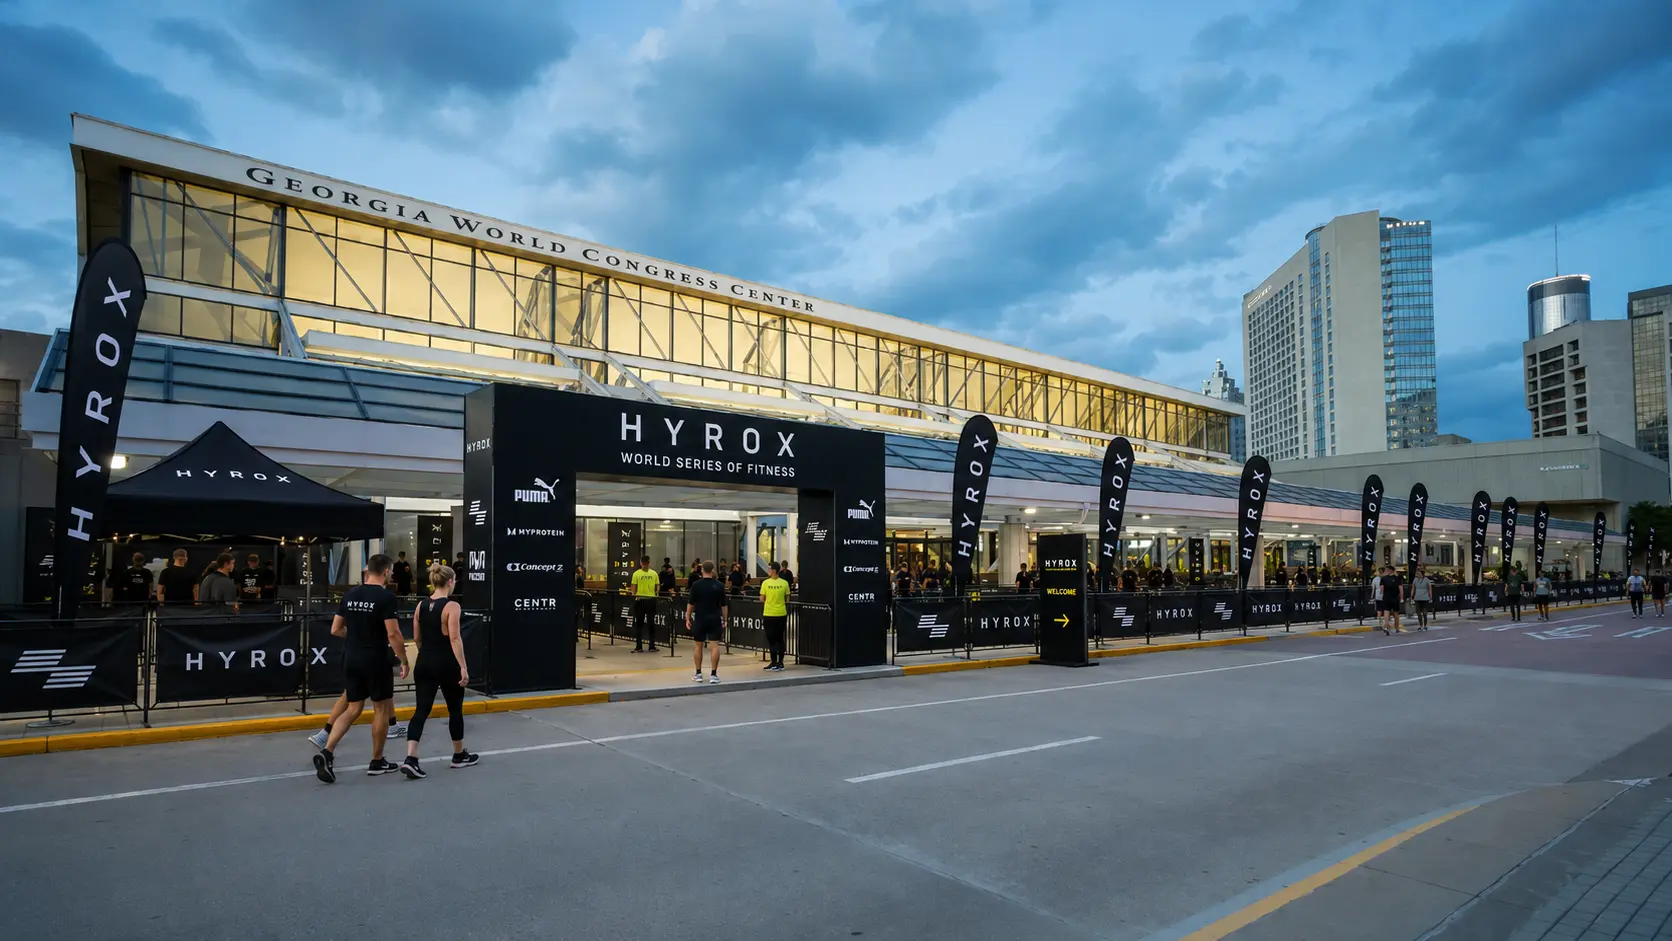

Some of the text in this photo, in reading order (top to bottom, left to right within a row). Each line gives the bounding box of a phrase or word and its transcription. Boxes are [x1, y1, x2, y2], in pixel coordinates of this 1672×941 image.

[246, 167, 815, 313] GEORGIA WORLD CONGRESS CENTER
[67, 276, 131, 541] HYROX
[466, 437, 491, 453] HYROX
[620, 412, 795, 458] HYROX
[176, 470, 291, 484] HYROX
[620, 451, 795, 478] WORLD SERIES OF FITNESS
[514, 489, 550, 503] PUMA
[958, 434, 990, 557] HYROX
[1103, 453, 1128, 558] HYROX
[847, 508, 870, 519] PUMA
[1242, 469, 1265, 560] HYROX
[1365, 486, 1380, 561] HYROX
[518, 528, 565, 537] MYPROTEIN
[1410, 494, 1424, 562] HYROX
[1474, 501, 1488, 563] HYROX
[1504, 505, 1516, 563] HYROX
[1537, 510, 1547, 563] HYROX
[1045, 559, 1077, 568] HYROX
[514, 598, 556, 607] CENTR
[1046, 588, 1077, 596] WELCOME
[1156, 608, 1193, 619] HYROX
[1252, 603, 1282, 613] HYROX
[980, 615, 1030, 629] HYROX
[185, 647, 328, 671] HYROX
